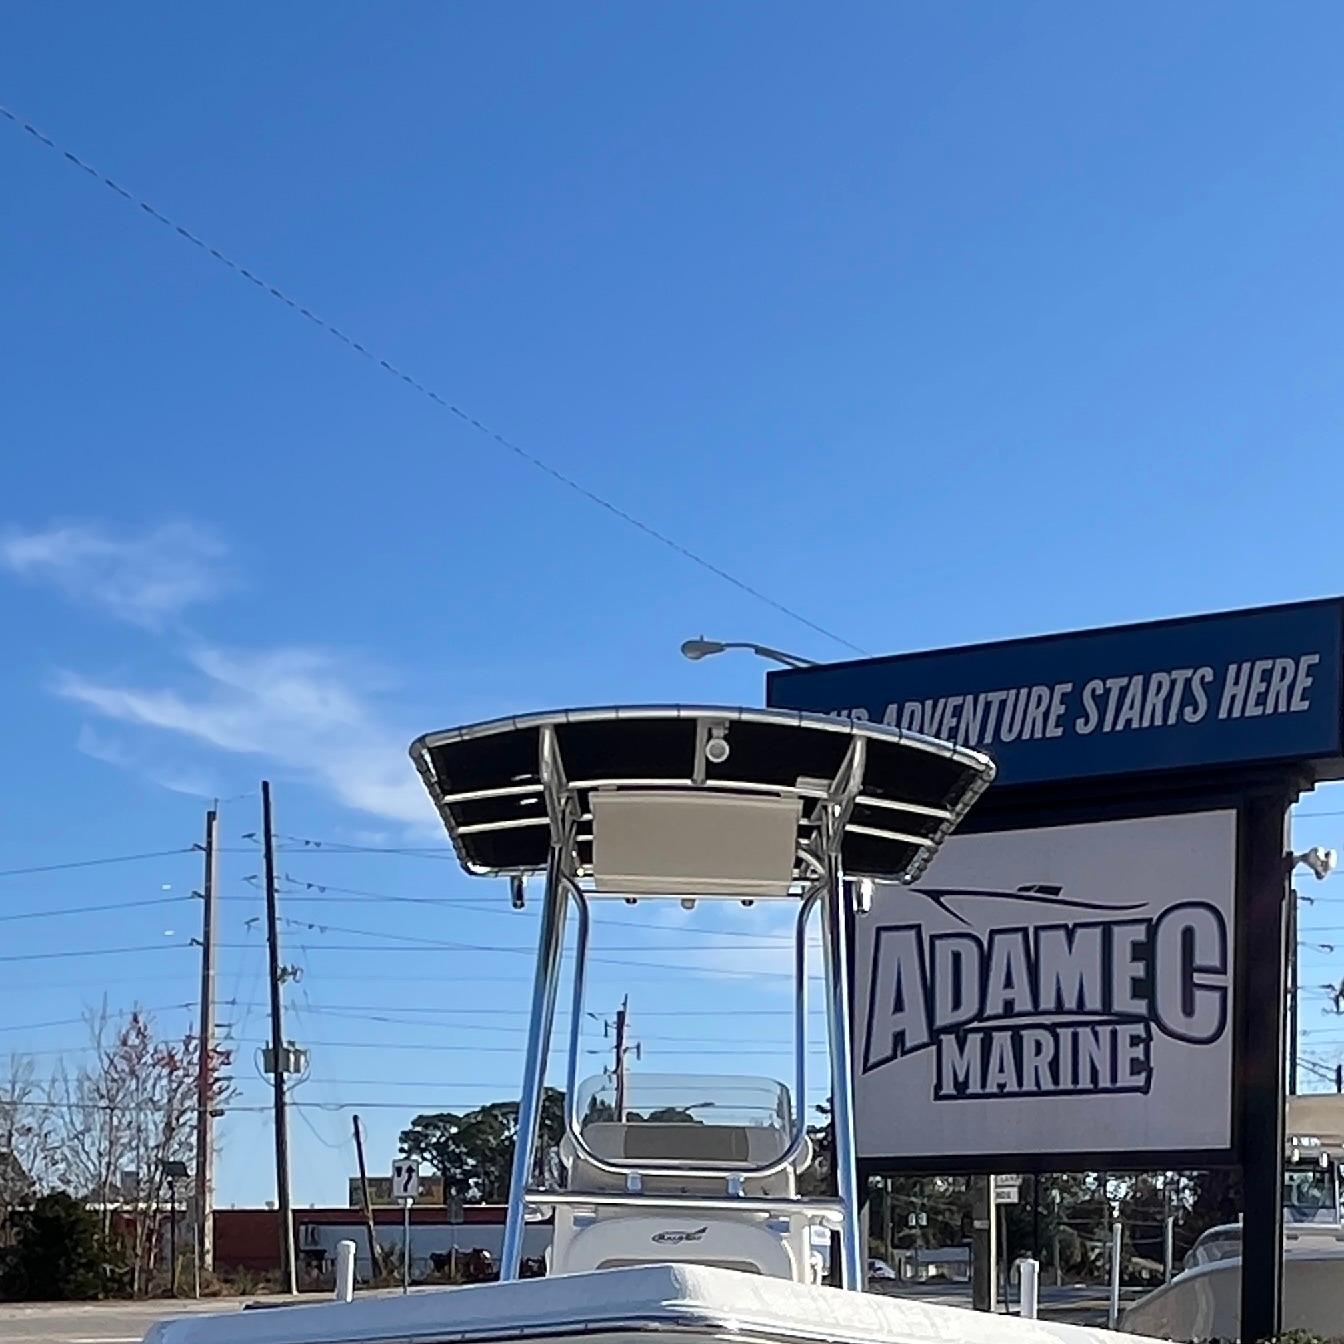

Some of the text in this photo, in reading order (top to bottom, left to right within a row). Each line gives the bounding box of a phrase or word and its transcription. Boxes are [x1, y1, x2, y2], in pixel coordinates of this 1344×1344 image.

[1075, 667, 1214, 735] STARTS
[1219, 654, 1320, 720] HERE
[862, 901, 1227, 1075] ADAMEC
[933, 1022, 1154, 1101] MARINE
